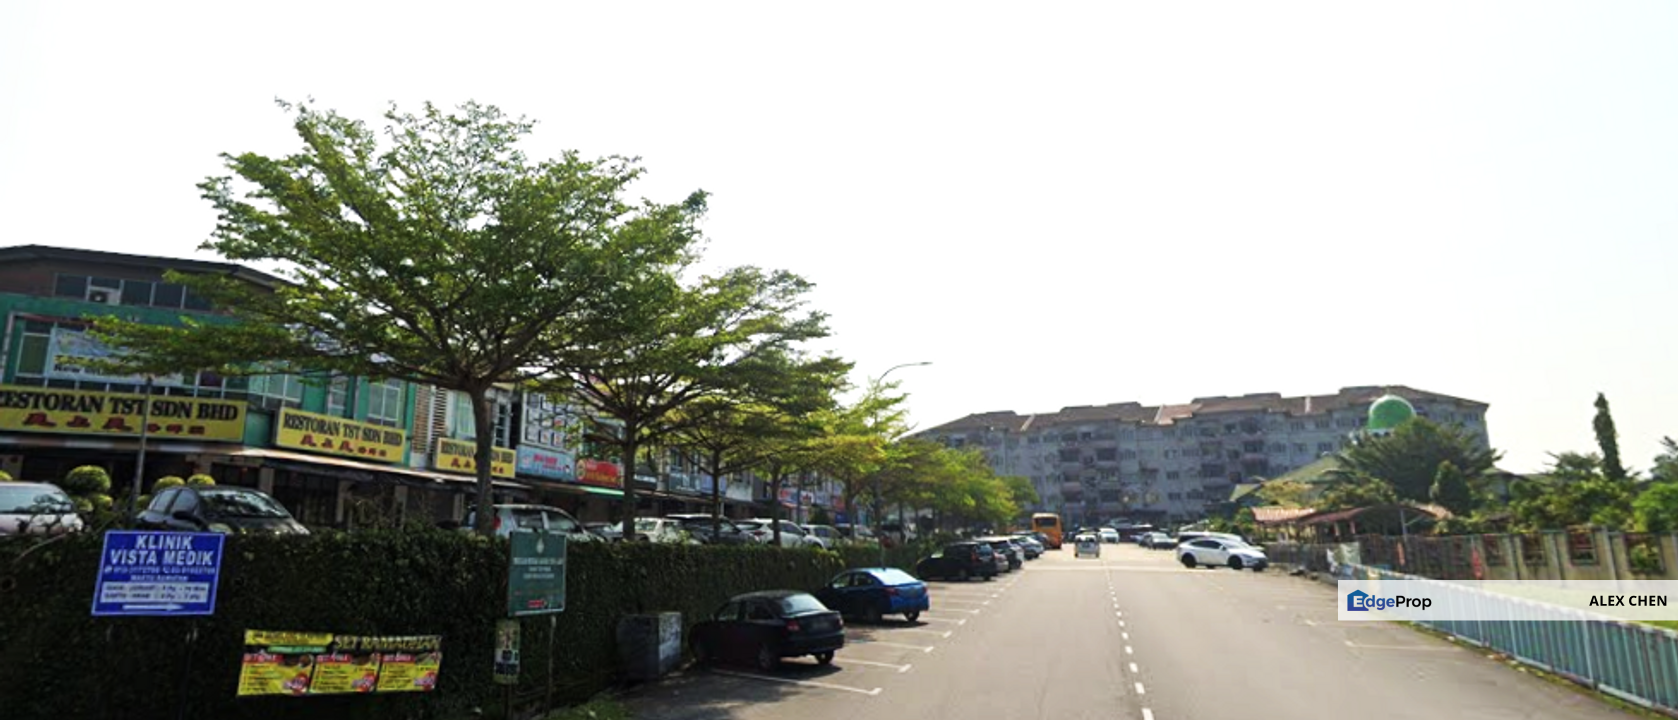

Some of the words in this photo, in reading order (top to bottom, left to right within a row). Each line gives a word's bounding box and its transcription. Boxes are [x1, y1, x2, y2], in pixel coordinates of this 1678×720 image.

[150, 400, 193, 419] SDN
[196, 402, 239, 421] BHD
[284, 413, 340, 437] RESTORAN
[343, 422, 361, 439] TST
[363, 426, 381, 443] SDN
[135, 535, 193, 550] KLINIK
[110, 549, 158, 565] VISTA
[162, 550, 214, 566] MEDIK
